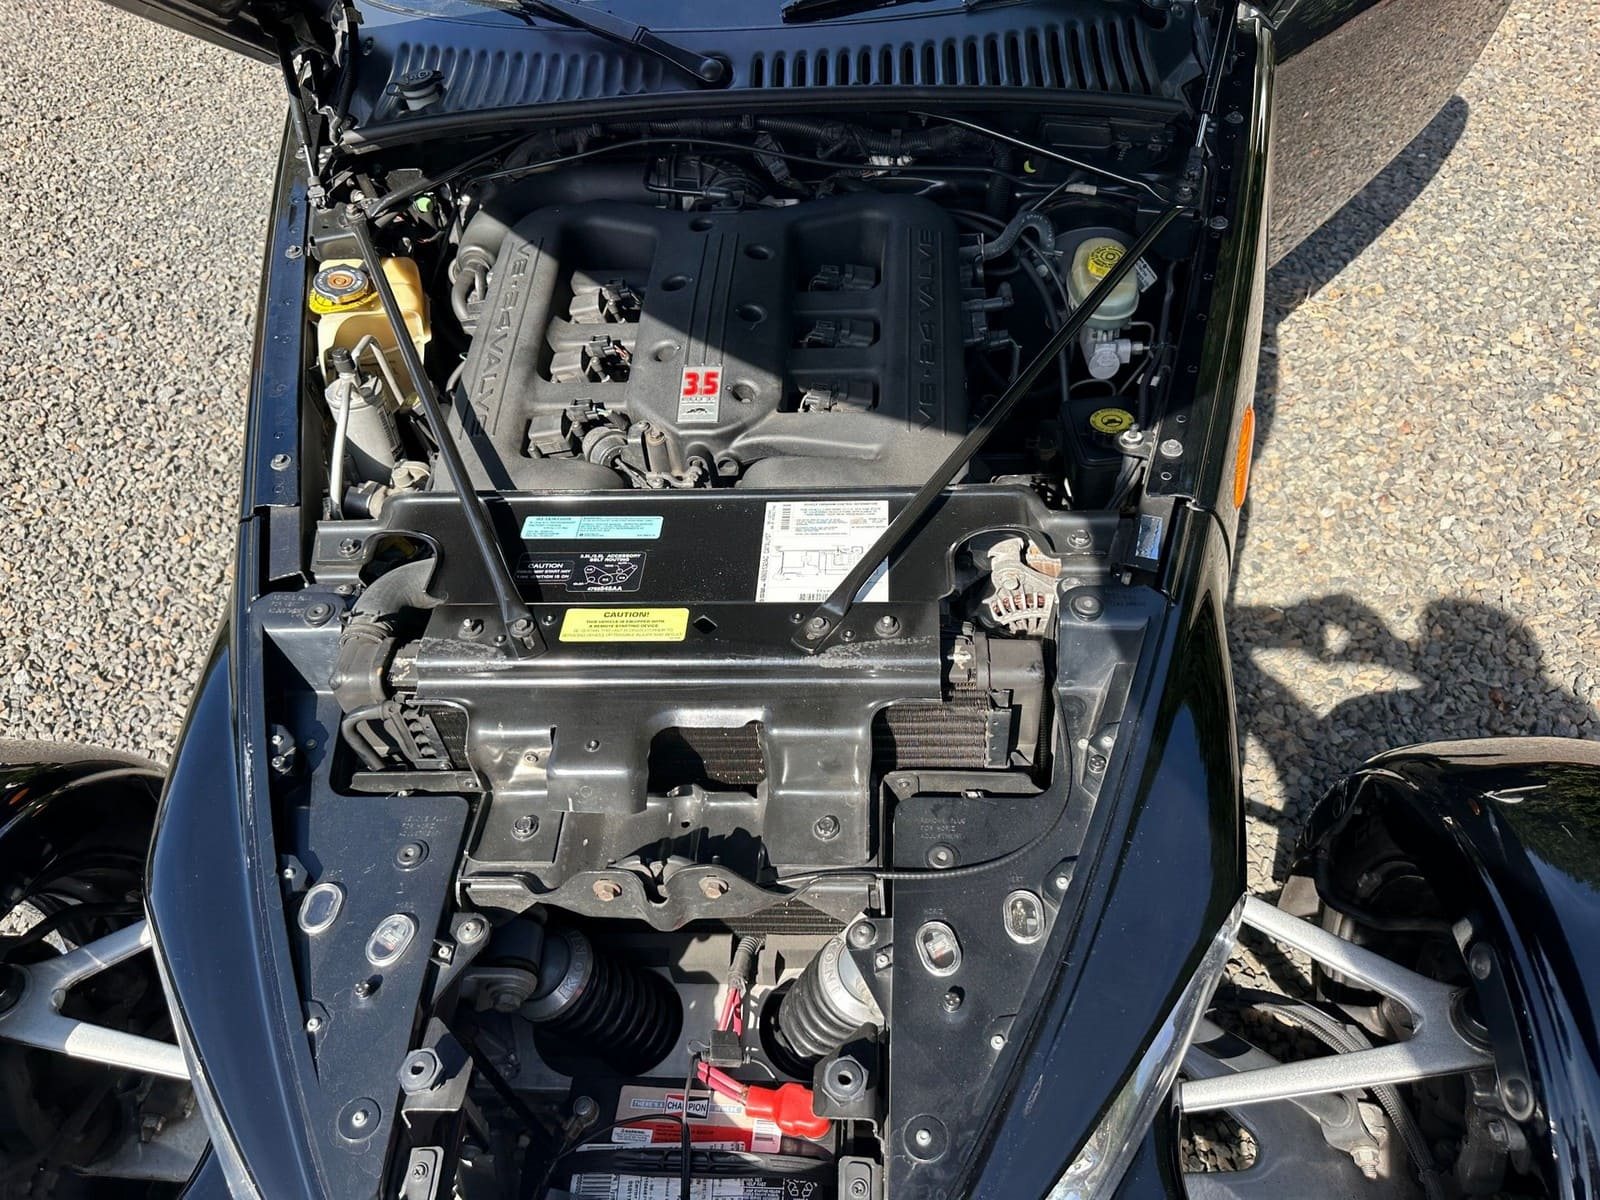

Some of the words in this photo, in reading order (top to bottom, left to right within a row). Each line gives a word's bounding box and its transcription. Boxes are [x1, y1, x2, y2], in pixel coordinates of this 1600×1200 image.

[918, 229, 936, 315] VALVE
[470, 333, 509, 437] VALVE
[667, 1101, 707, 1112] CHAPION
